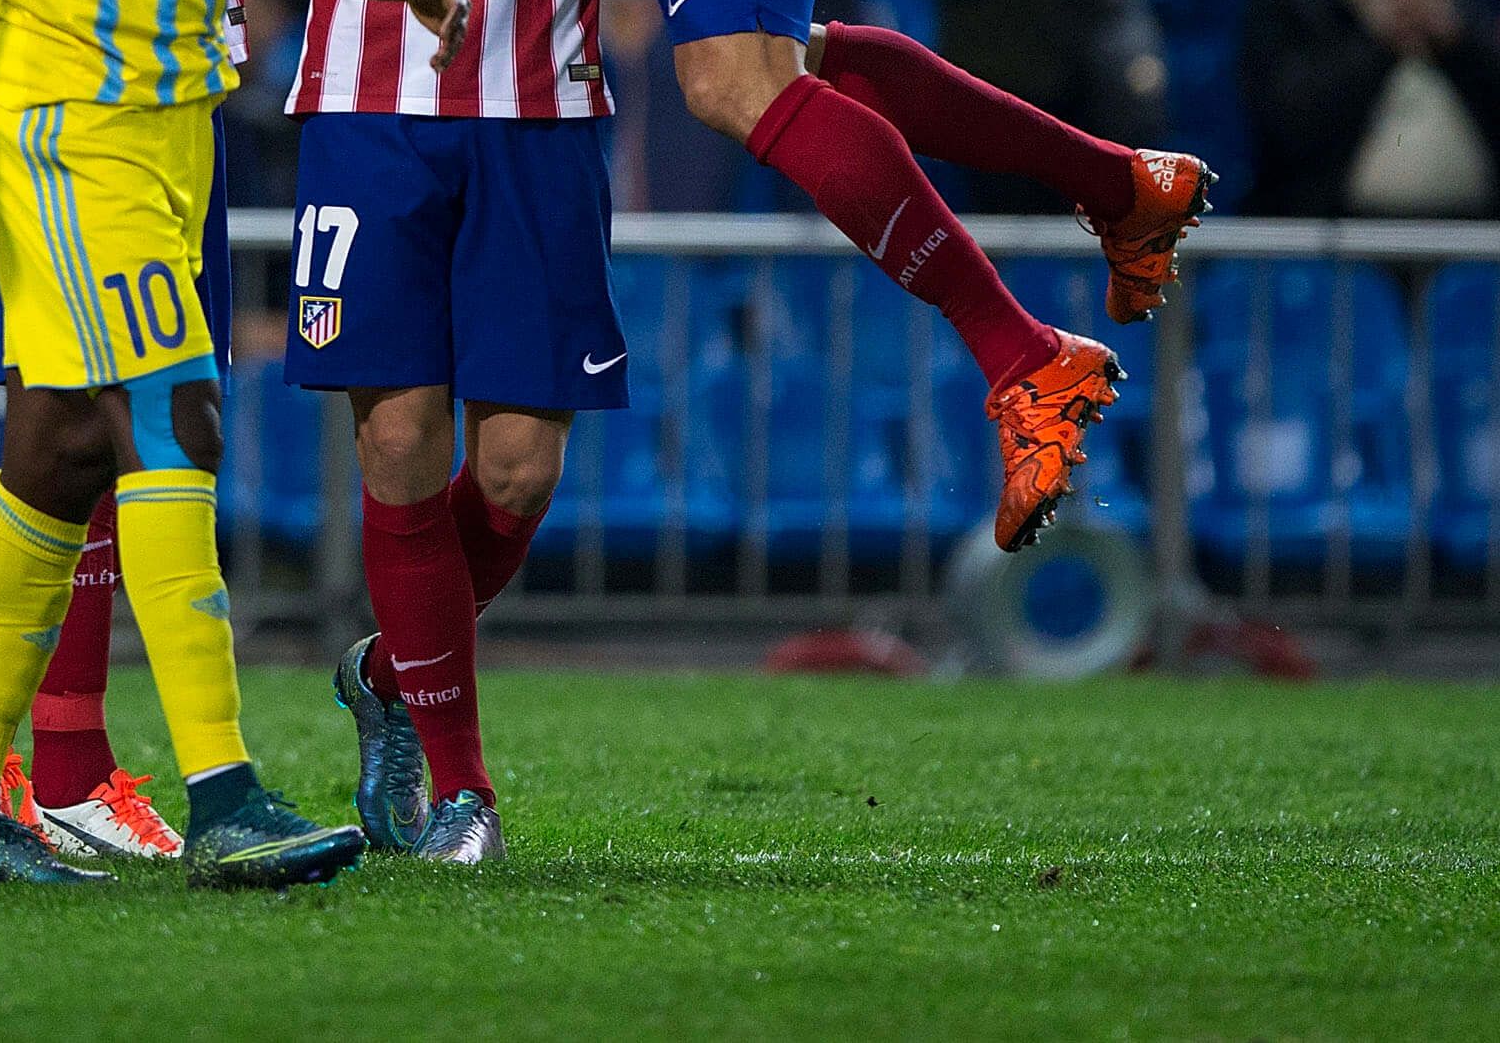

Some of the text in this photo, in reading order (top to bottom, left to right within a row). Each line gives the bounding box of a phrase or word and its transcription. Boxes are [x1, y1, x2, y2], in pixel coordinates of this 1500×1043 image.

[1160, 157, 1177, 193] adid
[295, 204, 359, 290] 17
[900, 227, 949, 289] ATLÉTICO
[103, 261, 187, 358] 10
